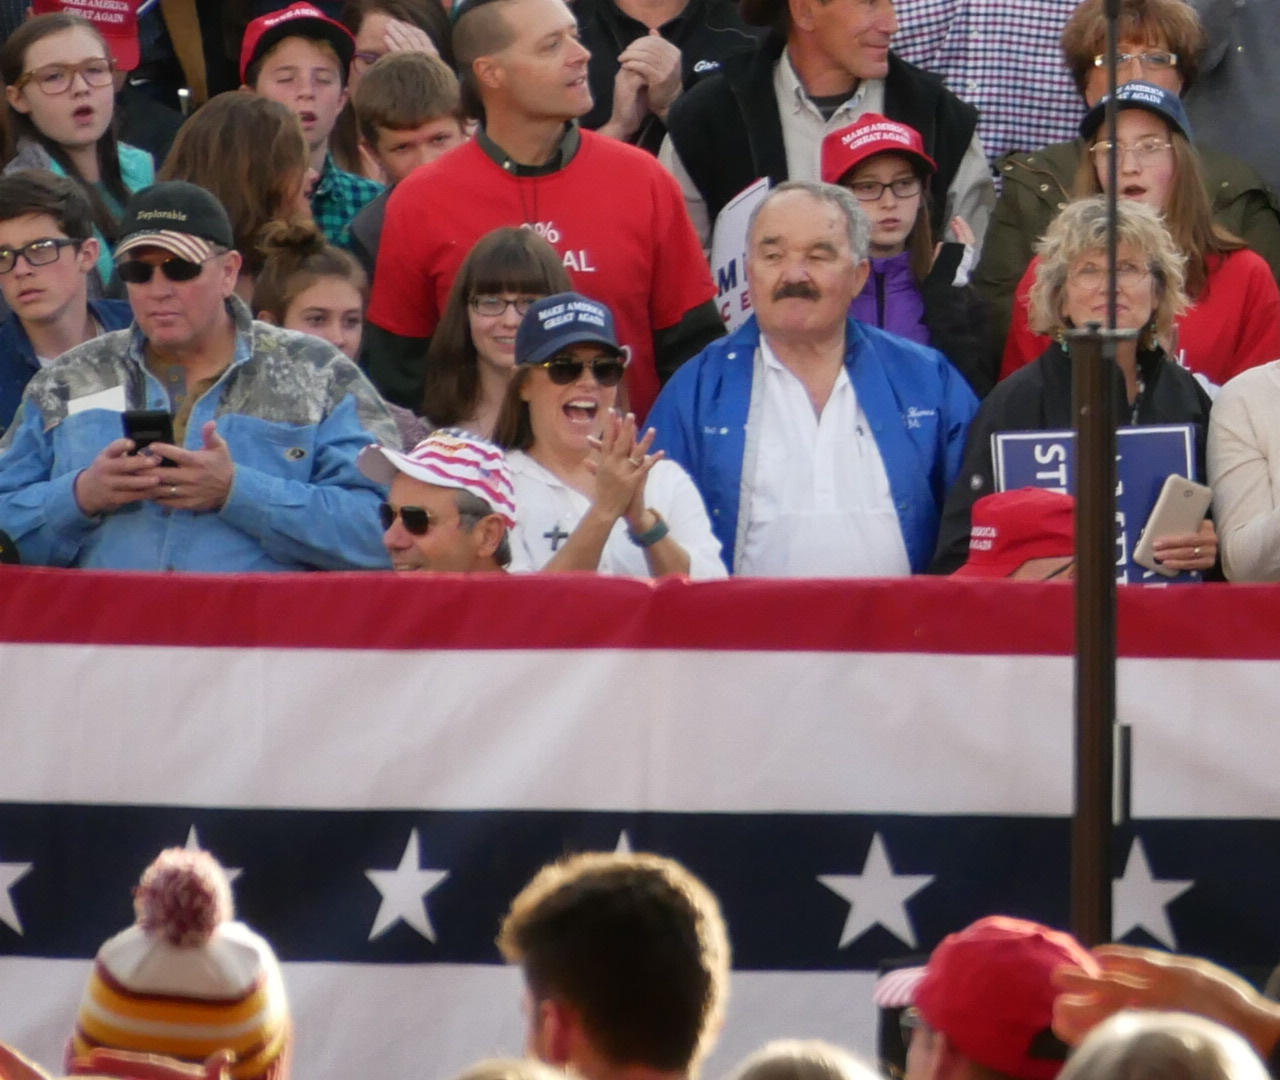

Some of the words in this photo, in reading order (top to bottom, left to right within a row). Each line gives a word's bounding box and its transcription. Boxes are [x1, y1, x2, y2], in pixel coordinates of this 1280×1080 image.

[94, 11, 124, 23] AGAIN
[1124, 84, 1164, 97] AMERICA
[1131, 93, 1161, 104] AGAIN
[842, 125, 870, 145] MAKE
[870, 123, 909, 138] AMERICA
[850, 132, 882, 149] GREAT
[883, 132, 910, 146] AGAIN
[137, 210, 187, 221] Deplorable
[538, 304, 565, 320] MAKE
[567, 301, 605, 318] AMERICA
[544, 313, 575, 329] GREAT
[578, 313, 604, 327] AGAIN
